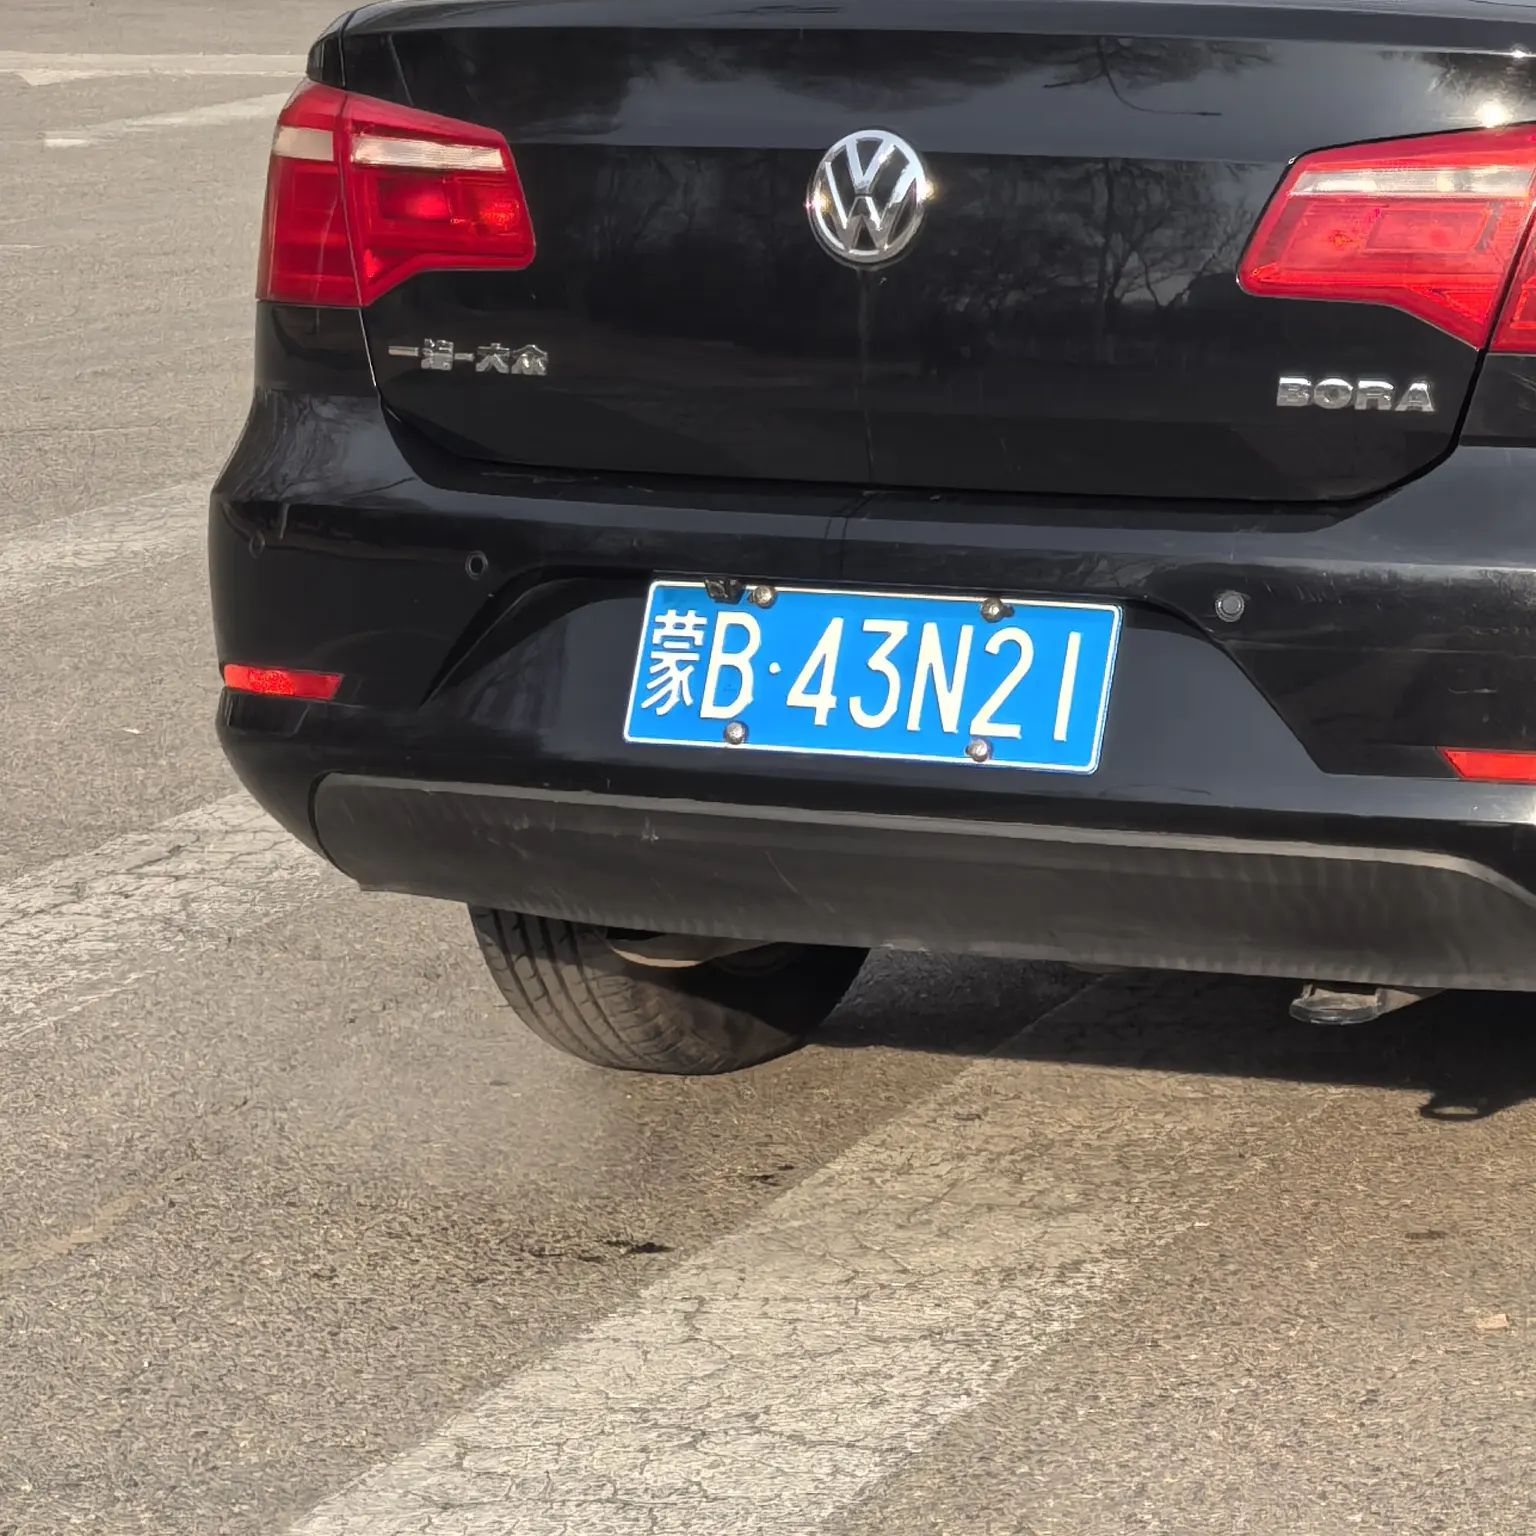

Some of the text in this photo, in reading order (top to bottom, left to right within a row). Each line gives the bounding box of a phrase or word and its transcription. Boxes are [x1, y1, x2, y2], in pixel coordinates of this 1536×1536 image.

[807, 130, 927, 264] VW
[1276, 375, 1436, 412] BORA
[640, 609, 1082, 742] 蒙B·43N21
